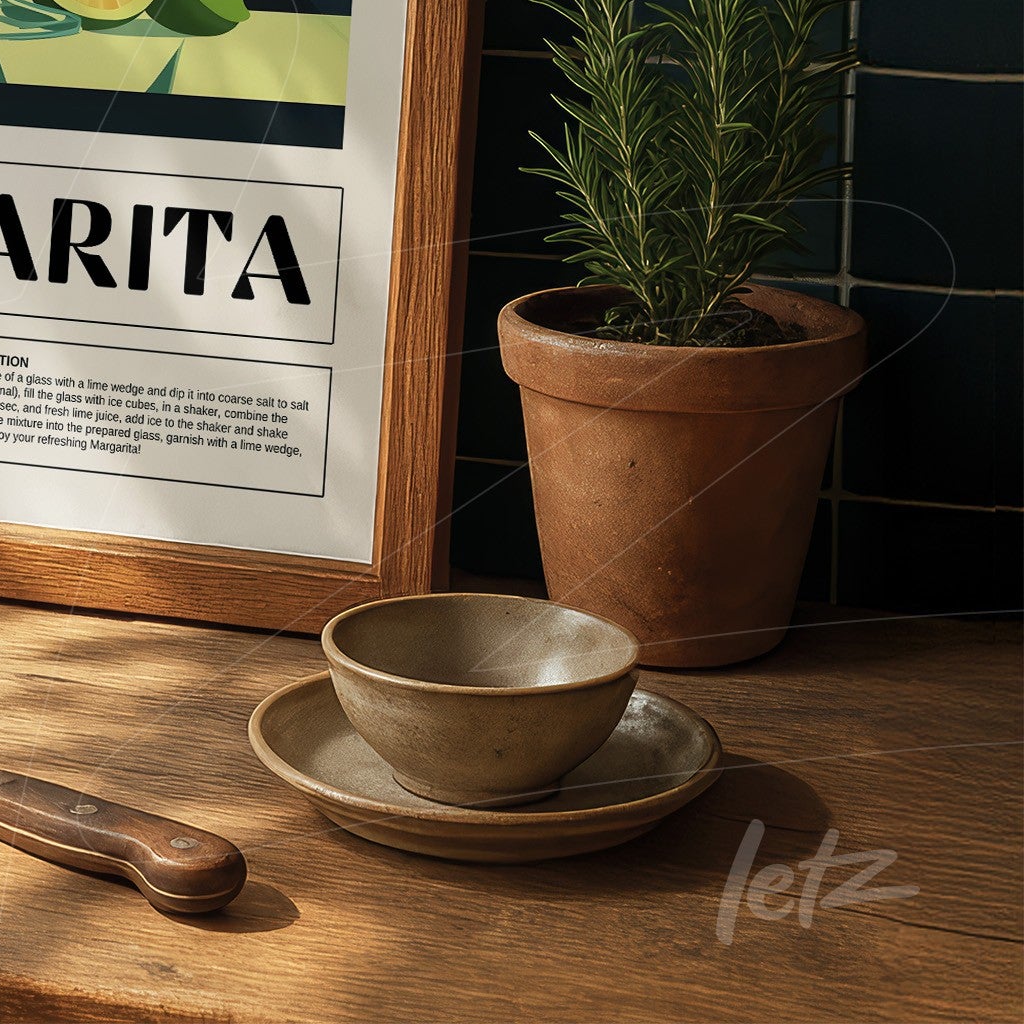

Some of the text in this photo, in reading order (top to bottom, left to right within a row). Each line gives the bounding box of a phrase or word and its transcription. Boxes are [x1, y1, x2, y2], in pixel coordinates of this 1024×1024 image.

[4, 371, 16, 382] of
[16, 373, 24, 384] a
[25, 373, 53, 386] glass
[54, 376, 76, 388] with
[77, 379, 85, 389] a
[86, 378, 109, 392] lime
[110, 382, 145, 397] wedge
[146, 386, 167, 397] and
[168, 387, 186, 401] dip
[187, 388, 194, 400] it
[196, 389, 216, 402] into
[217, 393, 254, 406] coarse
[255, 396, 275, 408] salt
[277, 398, 288, 410] to
[290, 400, 309, 412] salt
[23, 386, 35, 399] fill
[37, 388, 54, 401] the
[55, 390, 83, 404] glass
[84, 393, 106, 406] with
[107, 395, 123, 408] ice
[124, 398, 159, 413] cubes,
[161, 400, 172, 413] in
[173, 404, 181, 414] a
[183, 403, 221, 419] shaker,
[224, 409, 269, 422] combine
[270, 411, 289, 424] the
[6, 415, 44, 429] mixture
[45, 418, 64, 432] into
[66, 421, 83, 434] the
[85, 425, 132, 439] prepared
[133, 428, 164, 443] glass,
[165, 433, 205, 446] garnish
[206, 436, 228, 449] with
[230, 440, 238, 450] a
[239, 438, 262, 452] lime
[264, 443, 302, 458] wedge,
[22, 403, 42, 415] and
[44, 404, 70, 417] fresh
[72, 407, 94, 420] lime
[94, 409, 122, 424] juice,
[124, 413, 145, 425] add
[146, 414, 163, 427] ice
[164, 417, 175, 428] to
[177, 417, 194, 430] the
[196, 420, 232, 434] shaker
[233, 425, 255, 436] and
[256, 426, 289, 440] shake
[12, 433, 36, 444] your
[37, 434, 88, 451] refreshing
[89, 439, 142, 455] Margarita!
